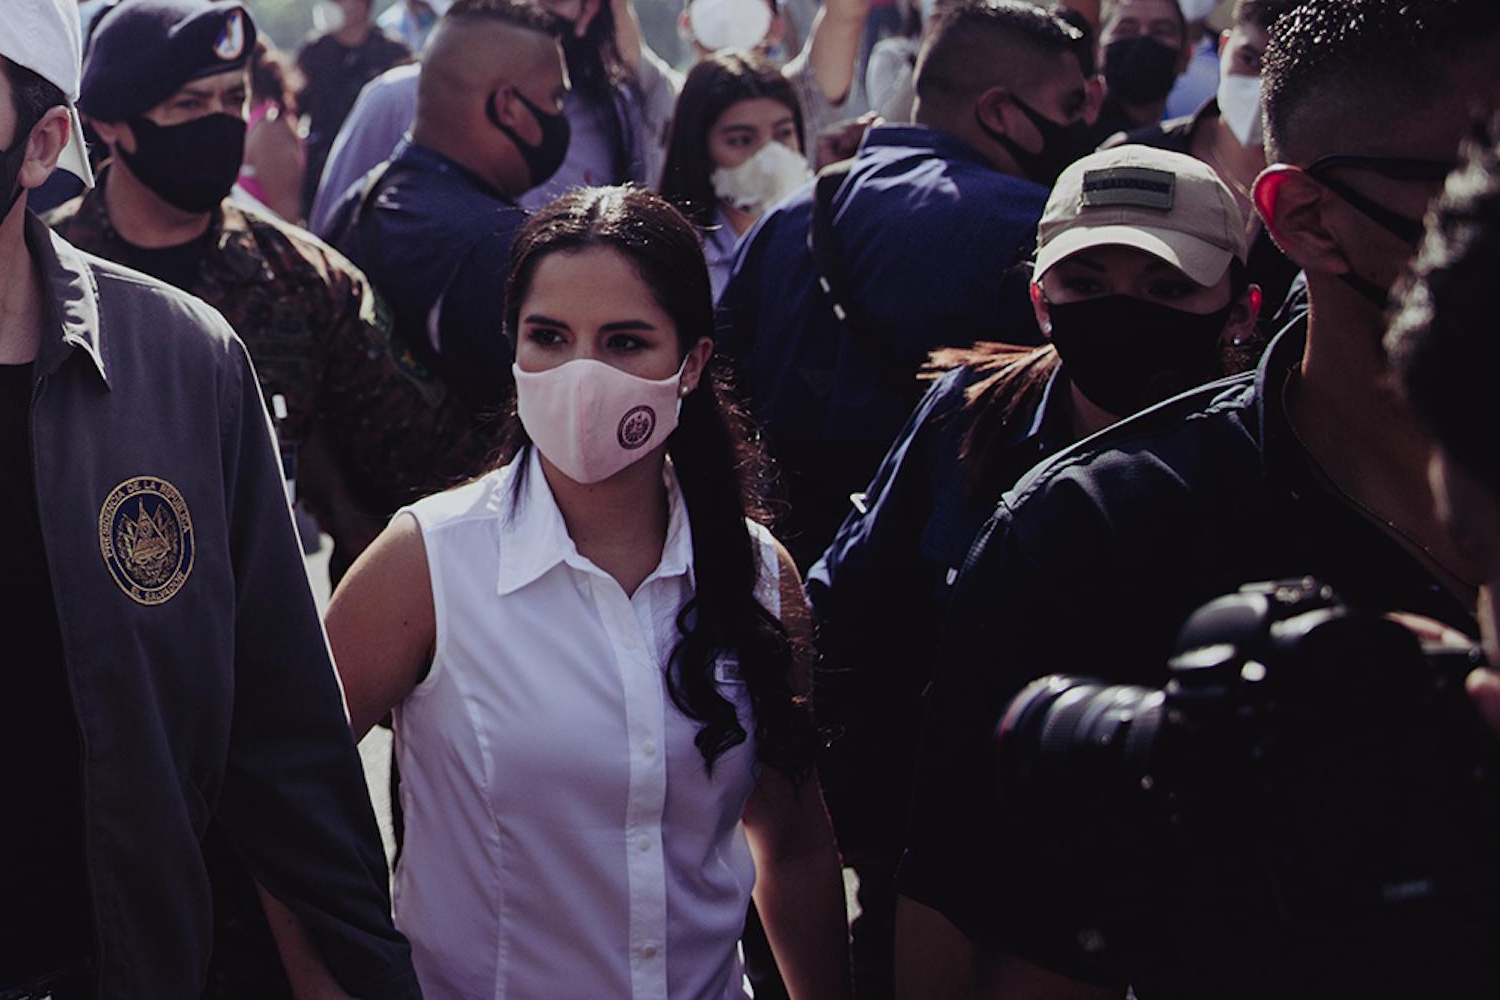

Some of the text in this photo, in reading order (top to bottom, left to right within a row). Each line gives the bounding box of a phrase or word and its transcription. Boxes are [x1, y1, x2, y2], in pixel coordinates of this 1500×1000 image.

[127, 481, 140, 491] DE
[143, 480, 156, 489] LA
[145, 571, 186, 602] SALVADOR
